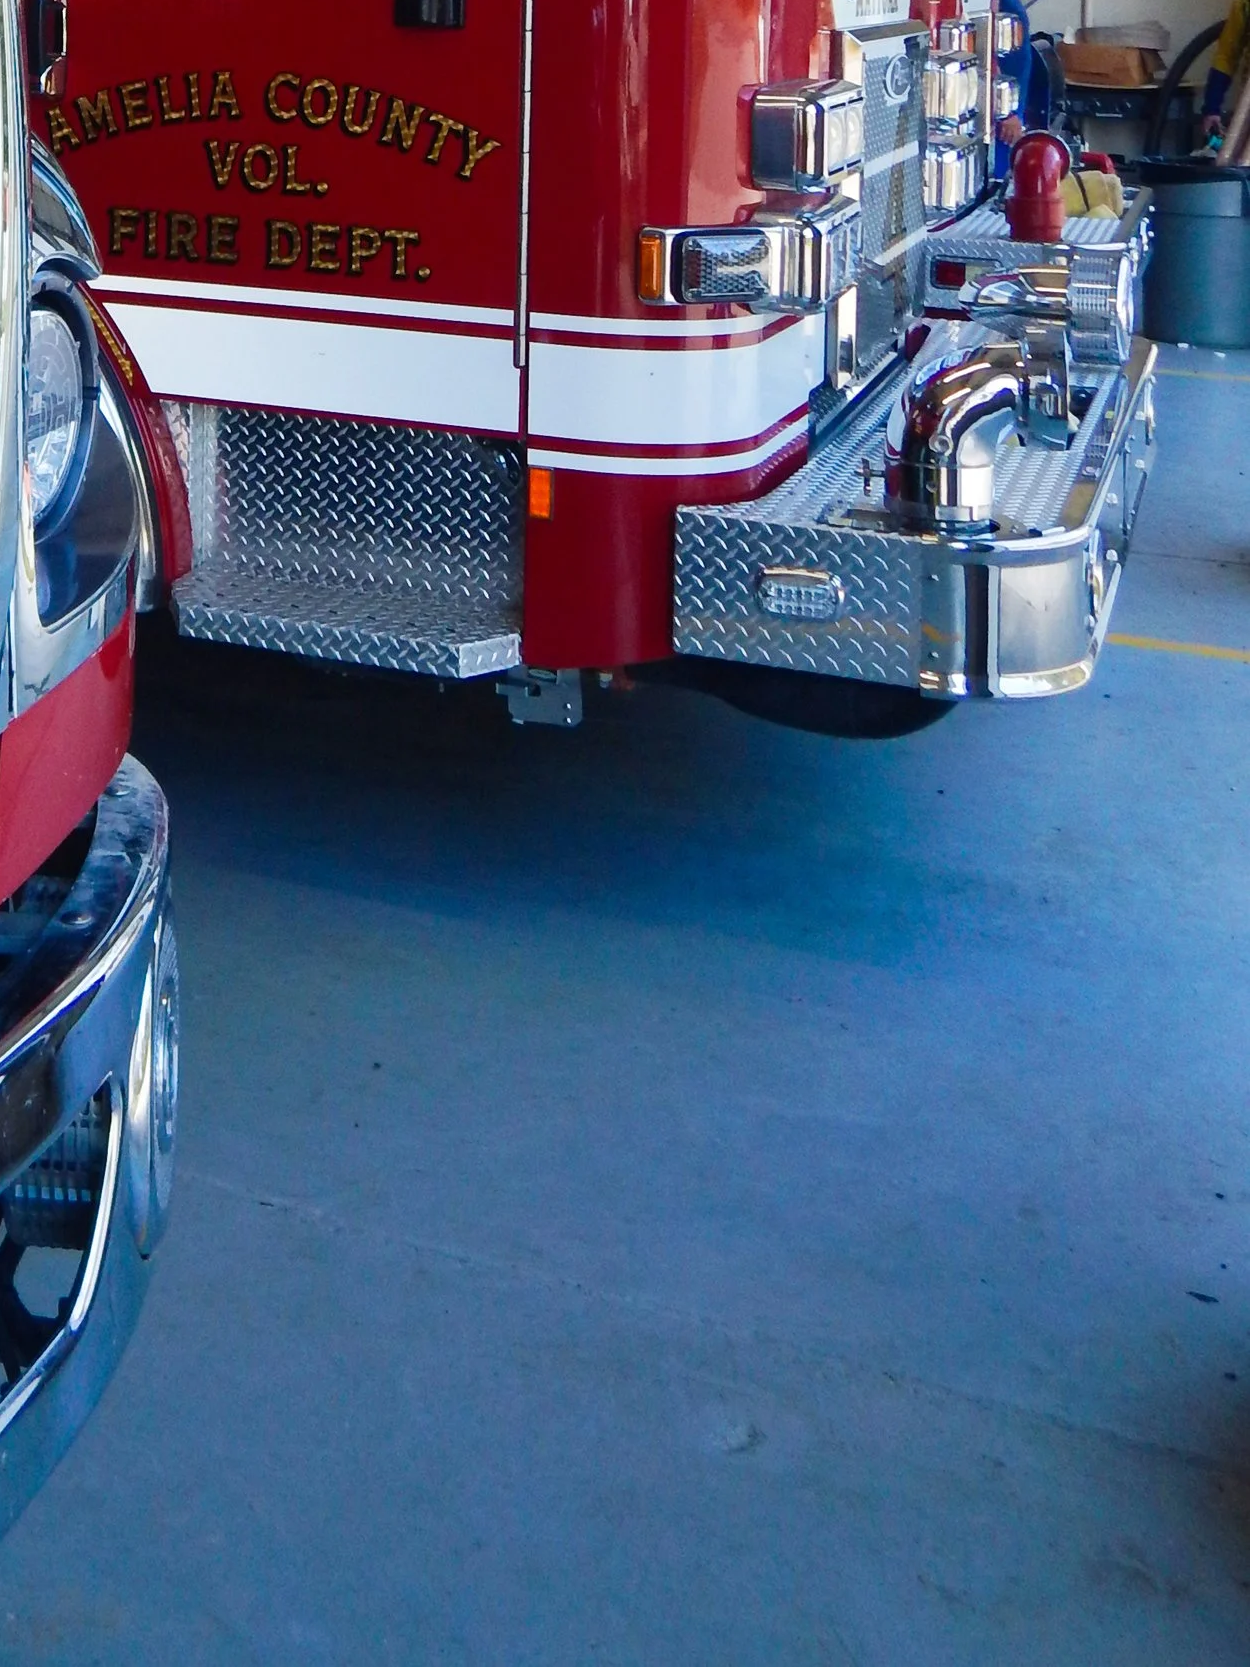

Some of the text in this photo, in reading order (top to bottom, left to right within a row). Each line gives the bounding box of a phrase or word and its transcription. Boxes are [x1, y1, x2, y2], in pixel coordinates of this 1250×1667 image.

[48, 71, 502, 180] AMELIA COUNTY
[206, 140, 330, 196] VOL.
[108, 208, 432, 280] FIRE DEPT.
